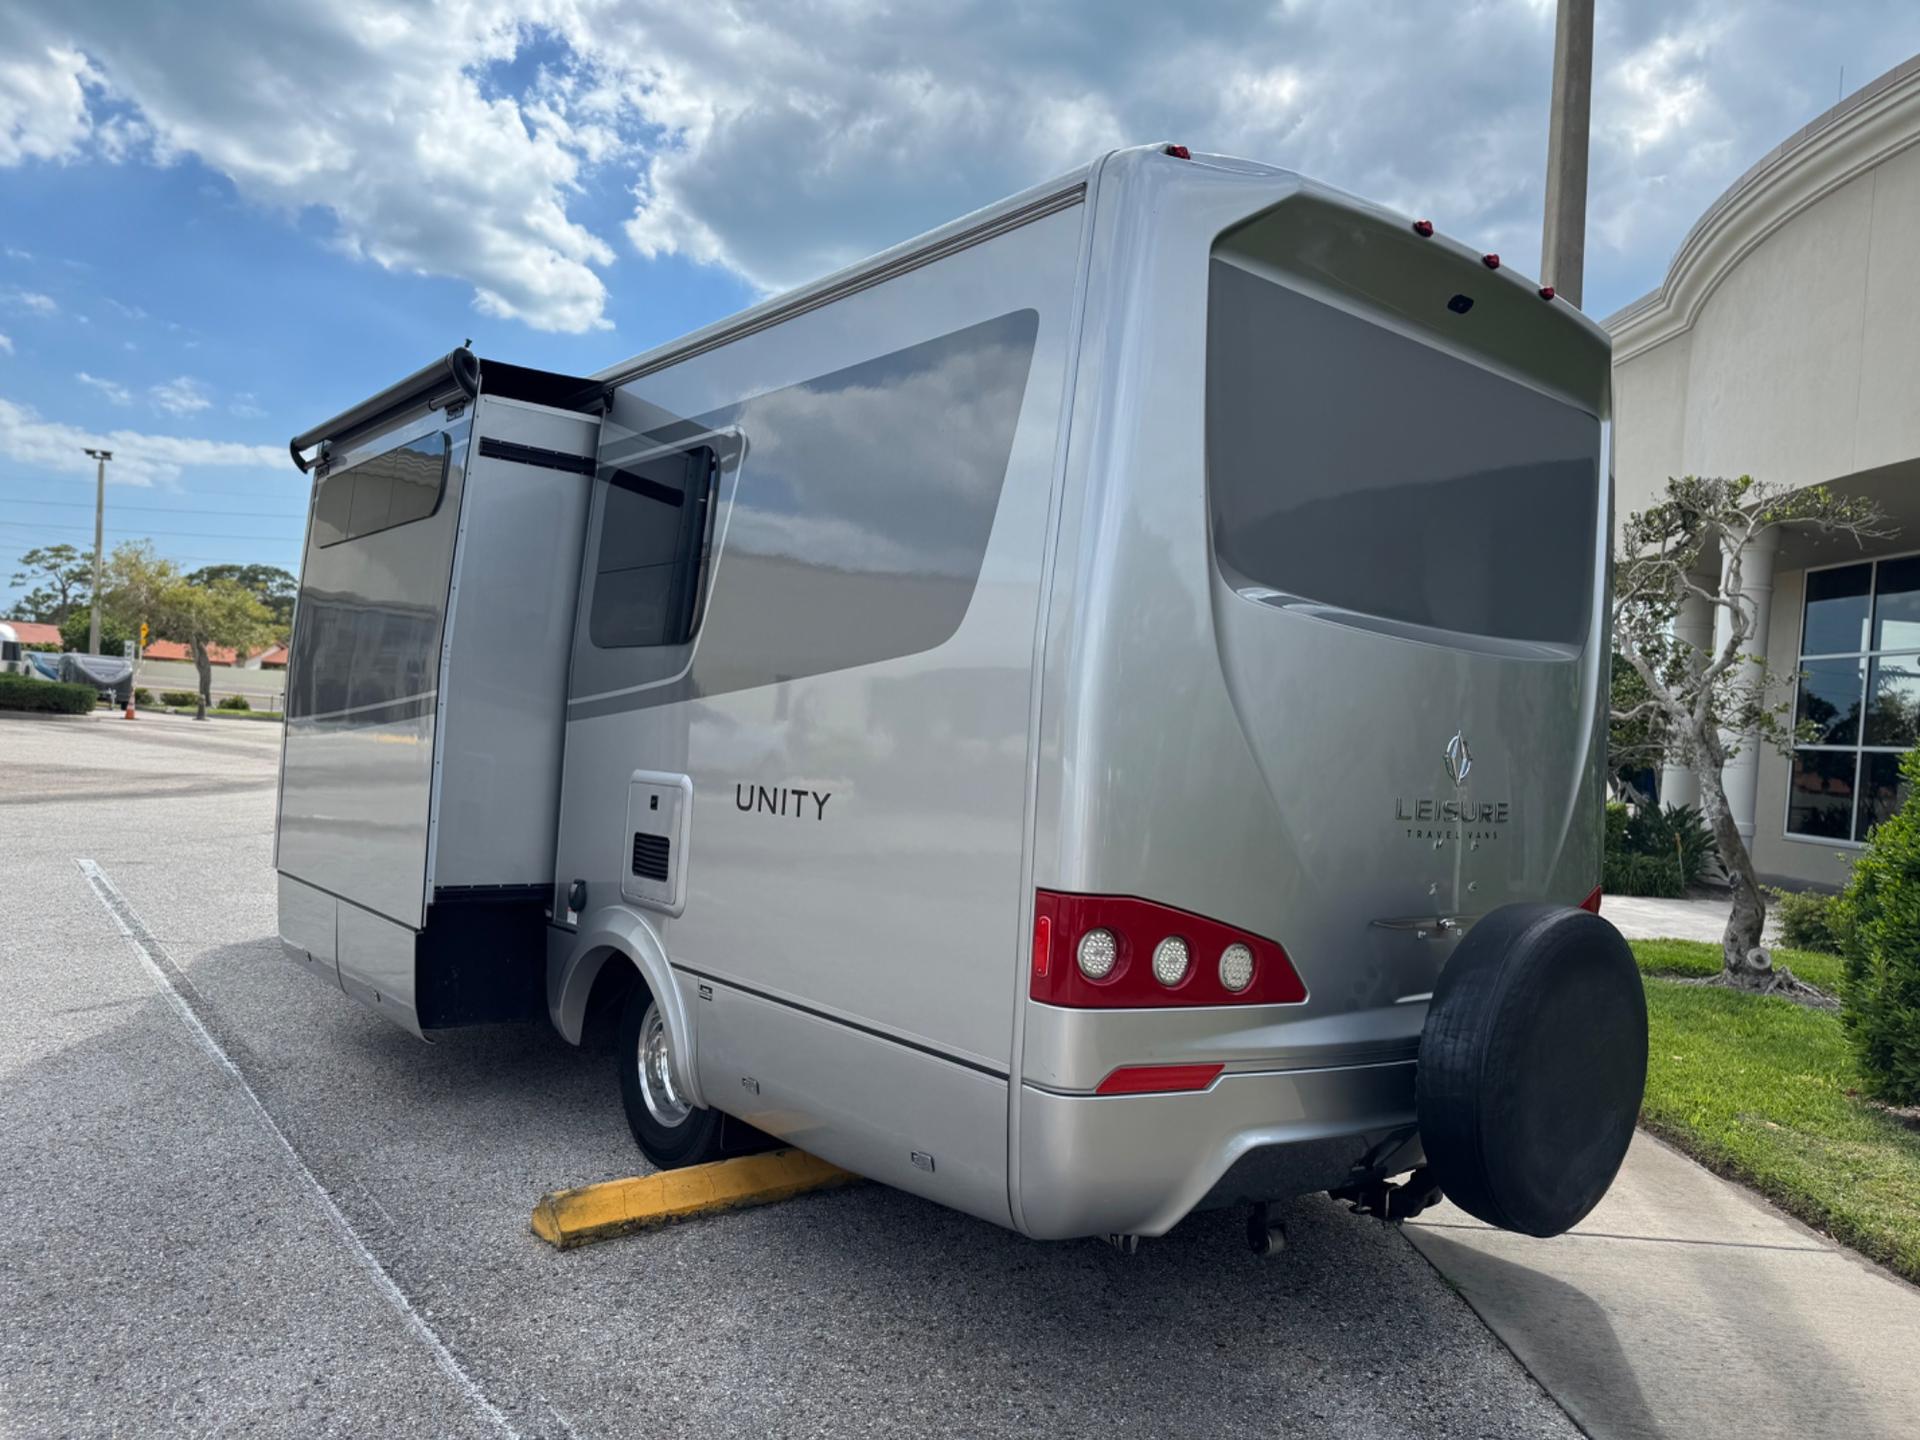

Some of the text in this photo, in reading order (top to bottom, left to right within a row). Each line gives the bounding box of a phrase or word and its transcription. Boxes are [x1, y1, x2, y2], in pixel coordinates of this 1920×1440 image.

[736, 783, 832, 820] UNITY
[1395, 798, 1509, 824] LEISURE
[1407, 829, 1460, 840] TRAVEL
